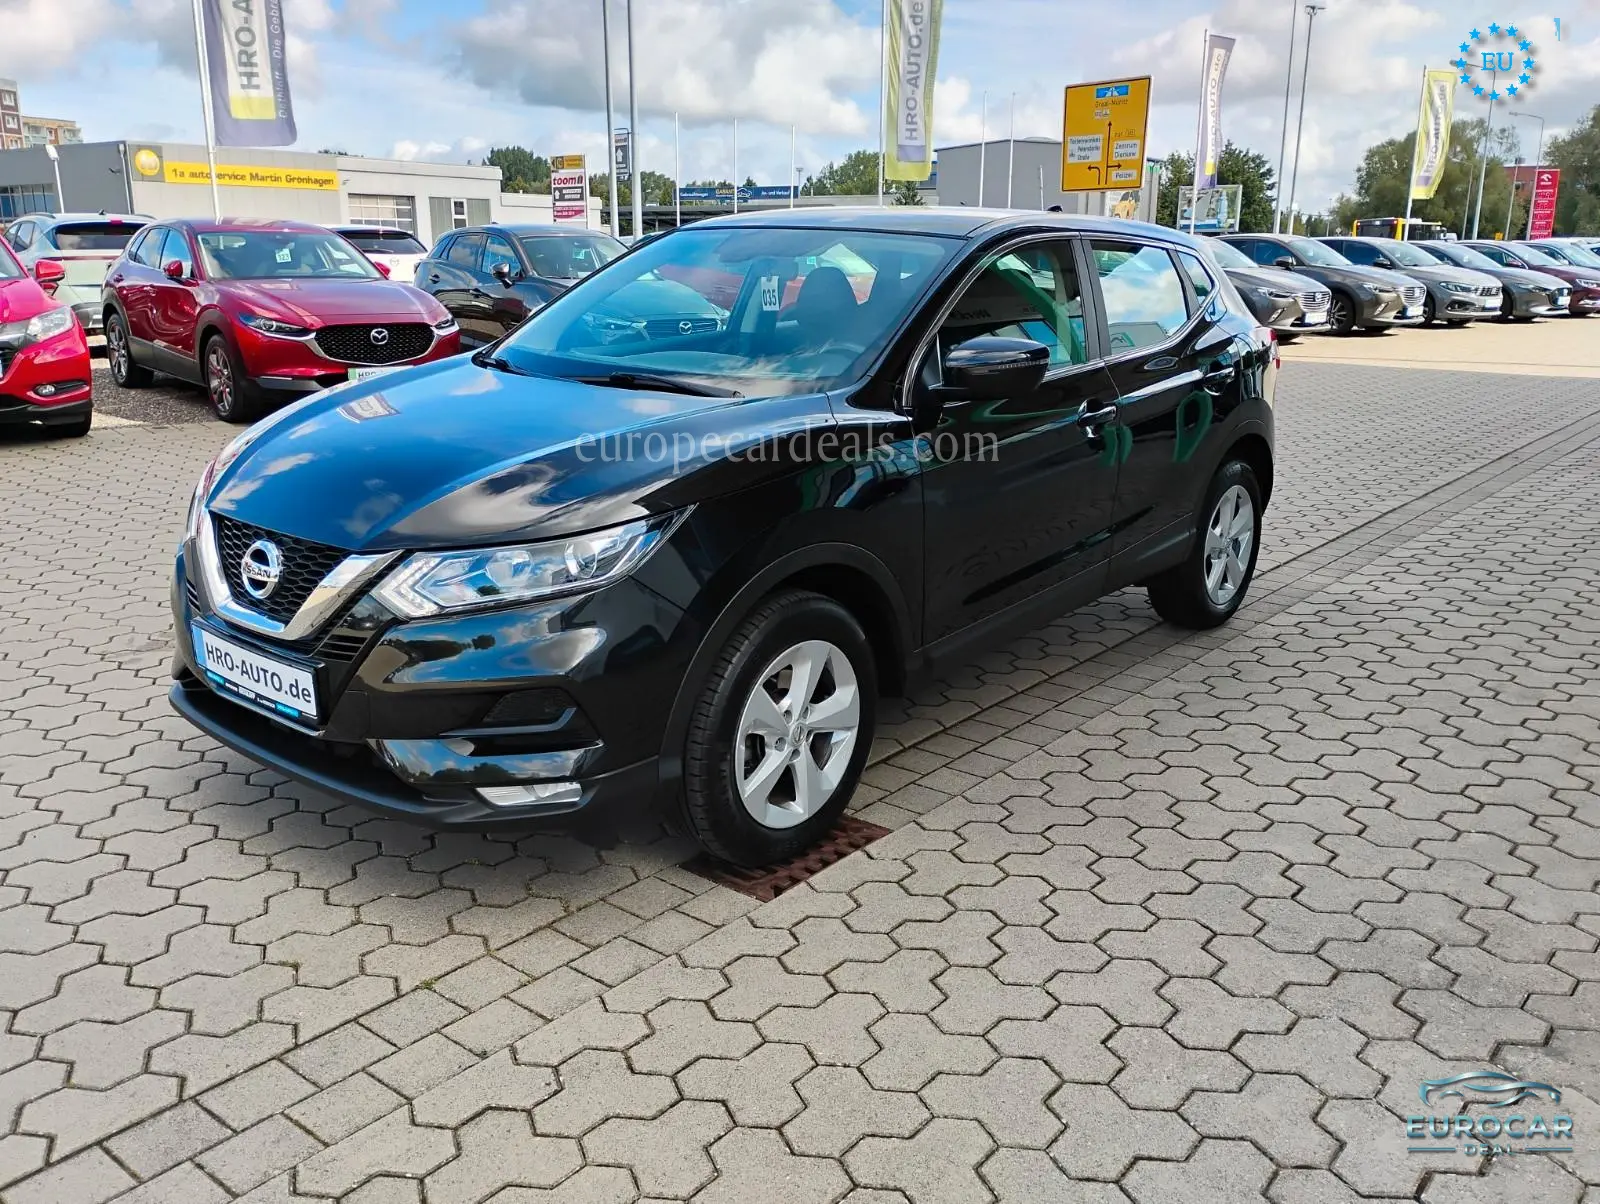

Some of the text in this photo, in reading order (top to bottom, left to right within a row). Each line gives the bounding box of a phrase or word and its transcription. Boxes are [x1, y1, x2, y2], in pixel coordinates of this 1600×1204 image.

[904, 1, 925, 141] HRO-AUTO.de
[172, 168, 185, 178] 1a
[188, 169, 246, 182] autoervice
[249, 173, 282, 183] Martin
[553, 176, 576, 186] toom
[762, 288, 777, 306] 035
[205, 642, 312, 704] HRO-AUTO.de
